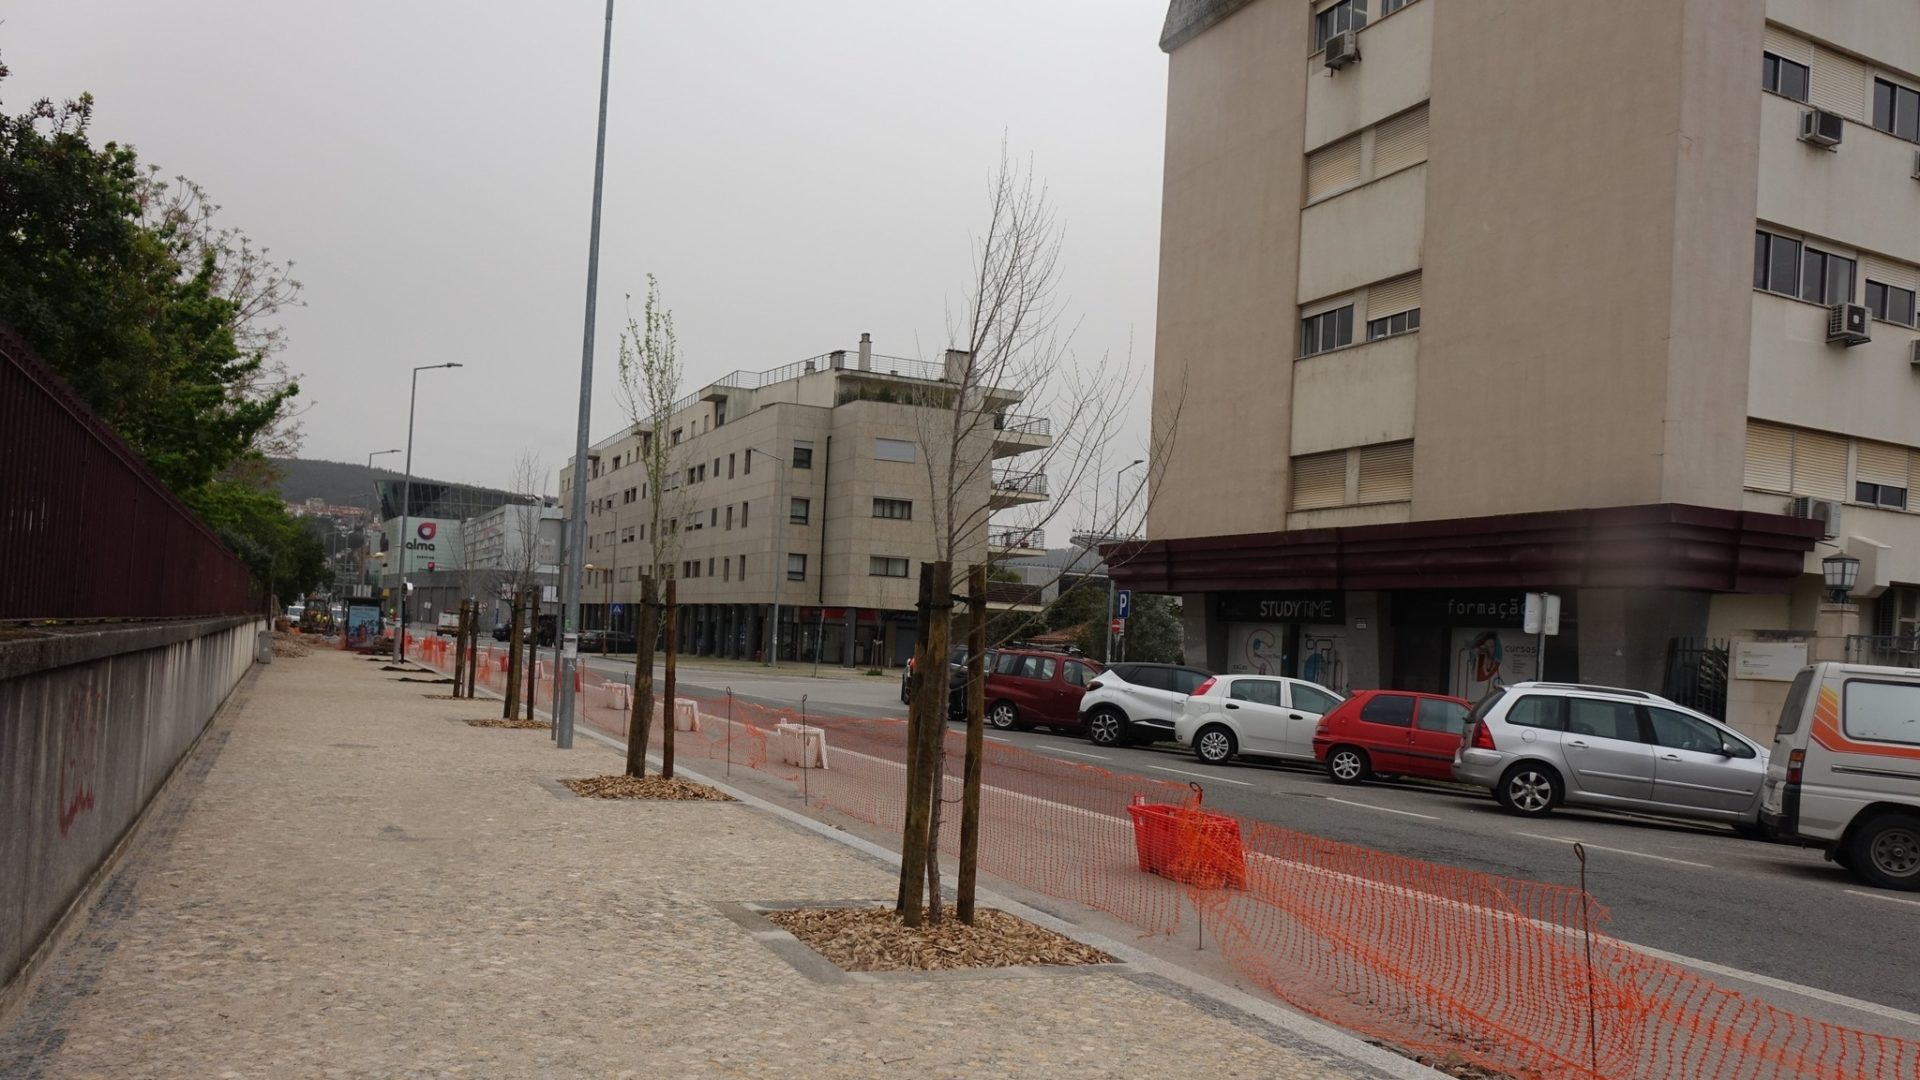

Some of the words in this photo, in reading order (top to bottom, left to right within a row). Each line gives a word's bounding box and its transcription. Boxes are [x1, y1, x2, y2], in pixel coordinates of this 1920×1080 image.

[405, 538, 435, 551] alma
[1119, 594, 1127, 615] P
[1505, 645, 1537, 654] cursos
